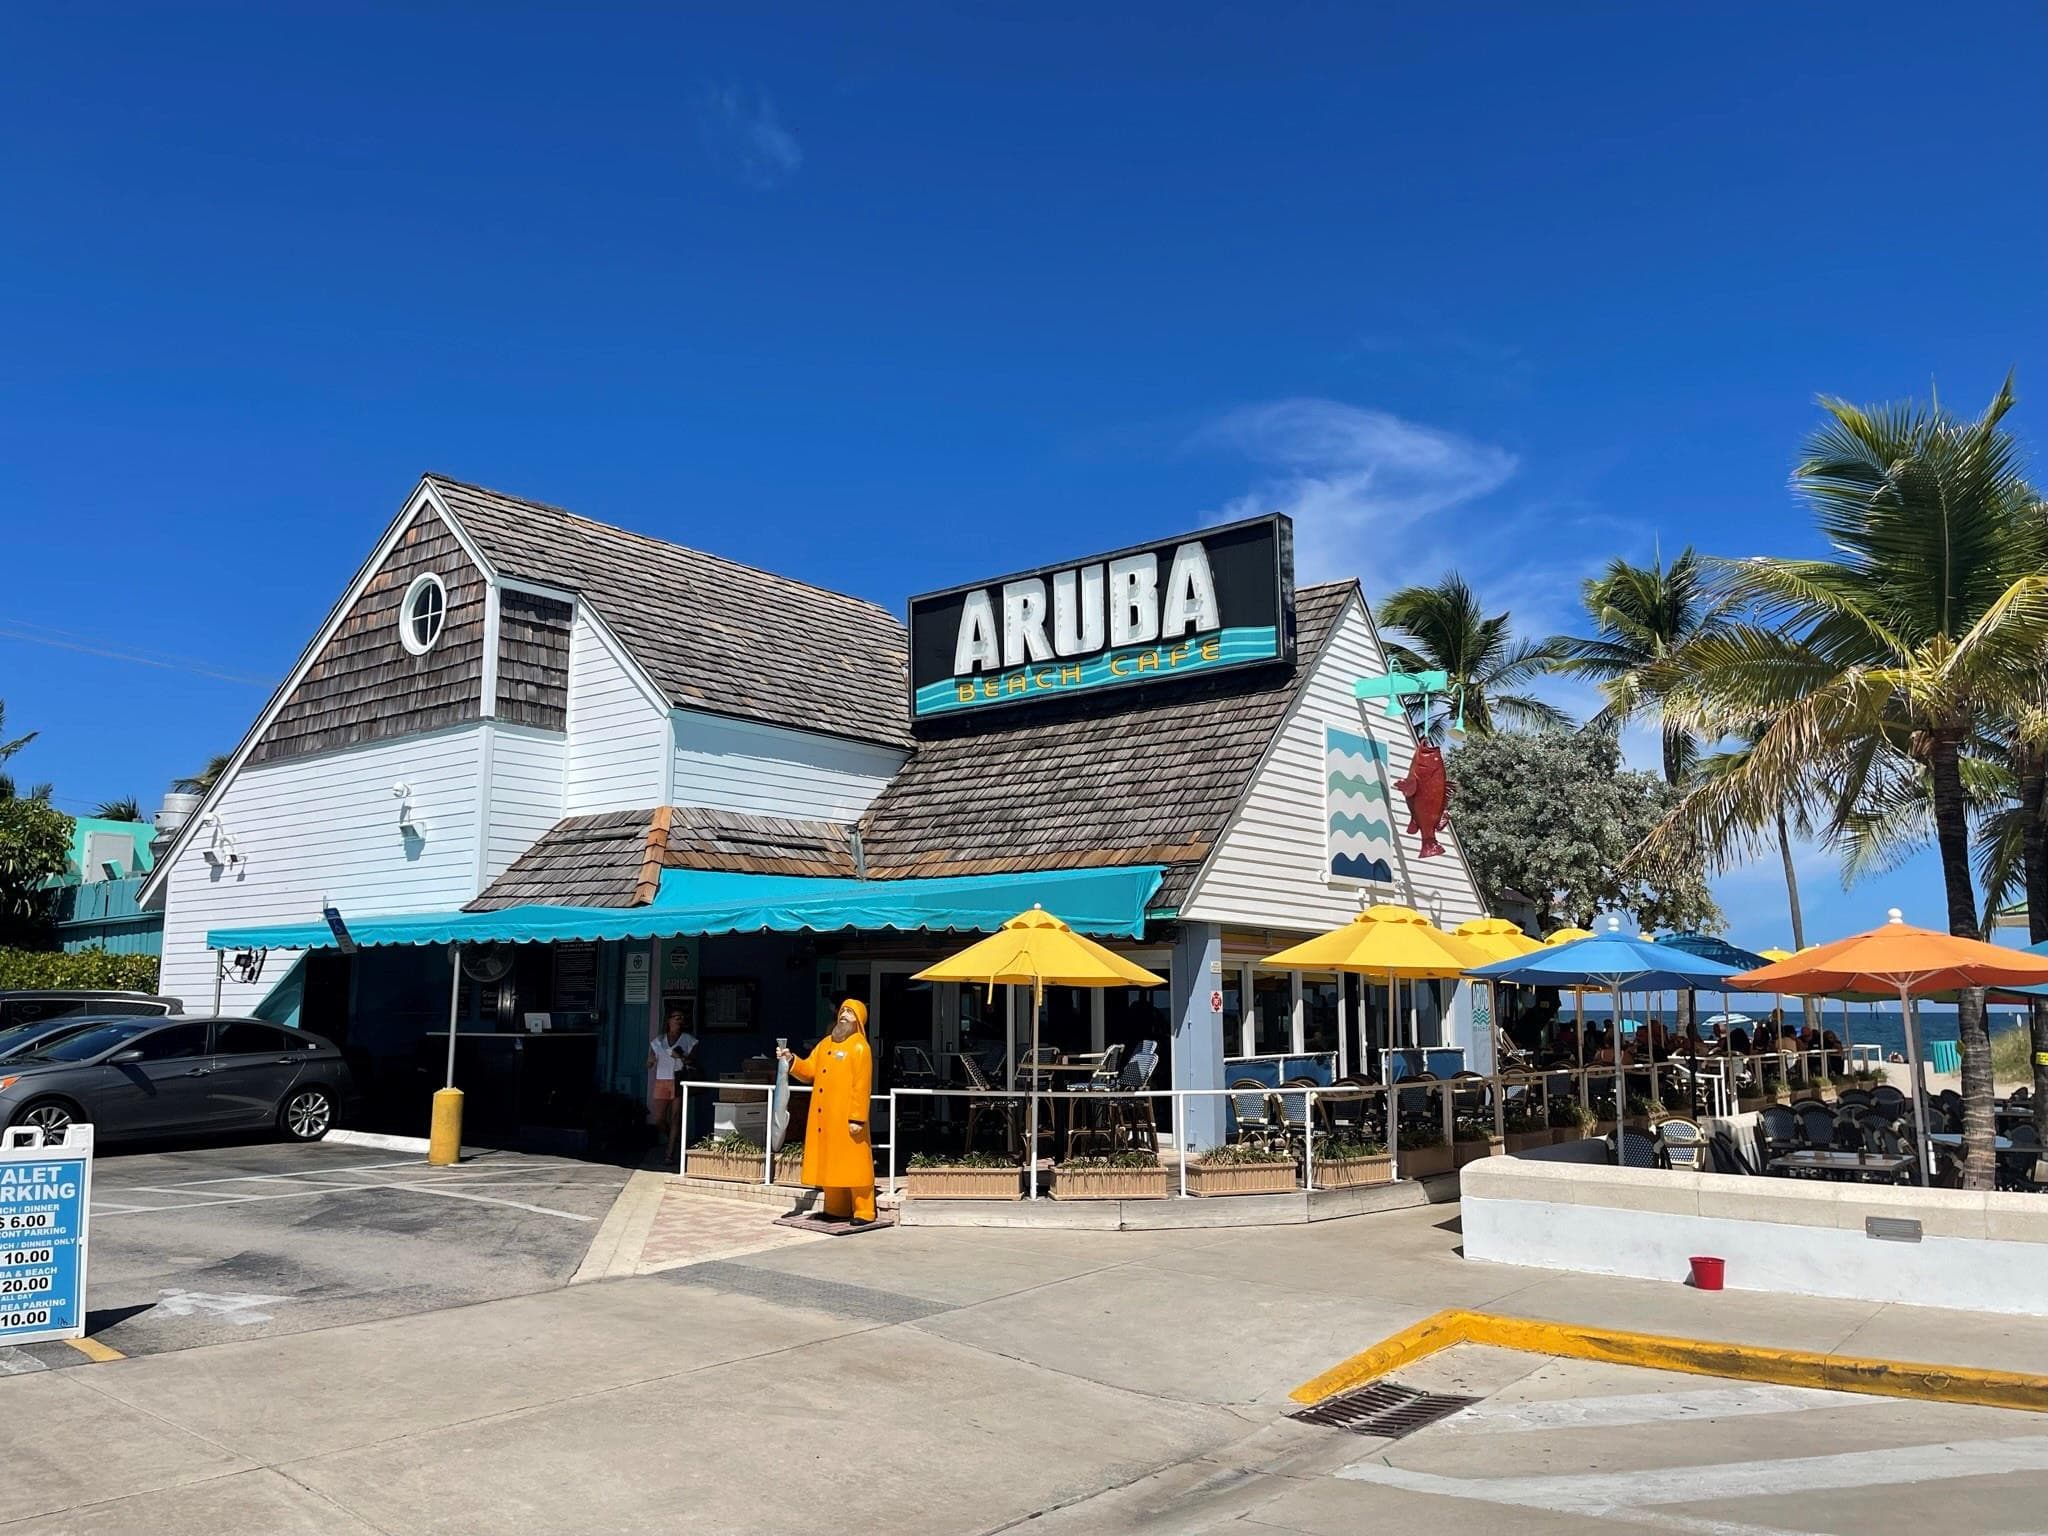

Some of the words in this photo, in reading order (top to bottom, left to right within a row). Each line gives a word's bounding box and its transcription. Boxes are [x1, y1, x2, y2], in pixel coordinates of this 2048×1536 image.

[953, 541, 1221, 676] ARUBA
[958, 662, 1082, 703] BEACH
[1110, 639, 1221, 676] CAFE
[0, 1167, 62, 1184] ALET
[0, 1183, 75, 1202] RKING
[24, 1204, 59, 1213] DINNER
[11, 1215, 46, 1228] 6.00
[0, 1230, 21, 1239] ONT
[24, 1227, 66, 1237] PARKING
[21, 1239, 52, 1248] DINNER
[54, 1237, 75, 1246] ONLY
[5, 1250, 49, 1264] 10.00
[25, 1267, 57, 1276] BEACH
[2, 1276, 49, 1293] 20.00
[1, 1294, 14, 1302] ALL
[23, 1299, 66, 1309] PARKING
[1, 1311, 47, 1327] 10.00
